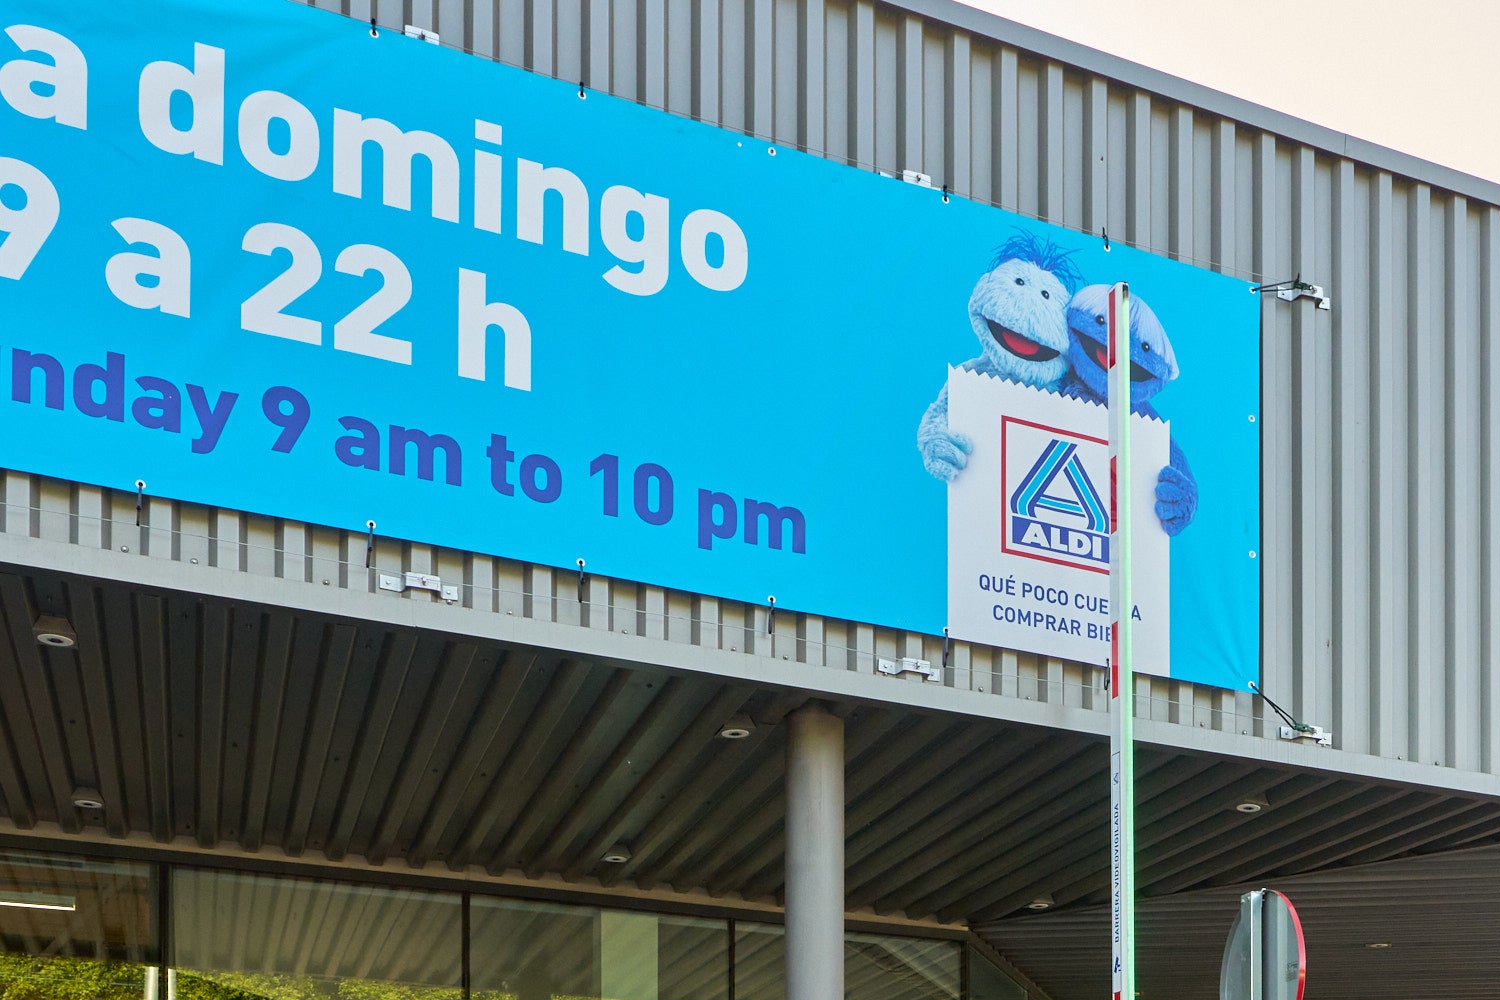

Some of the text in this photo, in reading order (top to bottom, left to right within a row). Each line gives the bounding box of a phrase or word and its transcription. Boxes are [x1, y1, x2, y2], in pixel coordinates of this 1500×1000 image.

[0, 24, 749, 297] a domingo
[0, 156, 532, 392] 9 a 22 h
[261, 385, 311, 454] 9
[334, 415, 463, 488] am
[486, 432, 563, 504] to
[589, 453, 674, 526] 10
[697, 487, 807, 555] pm
[1021, 522, 1102, 560] ALDI
[979, 574, 1142, 621] QUÉ POCO CUEA
[992, 605, 1111, 643] COMPRAR BIE
